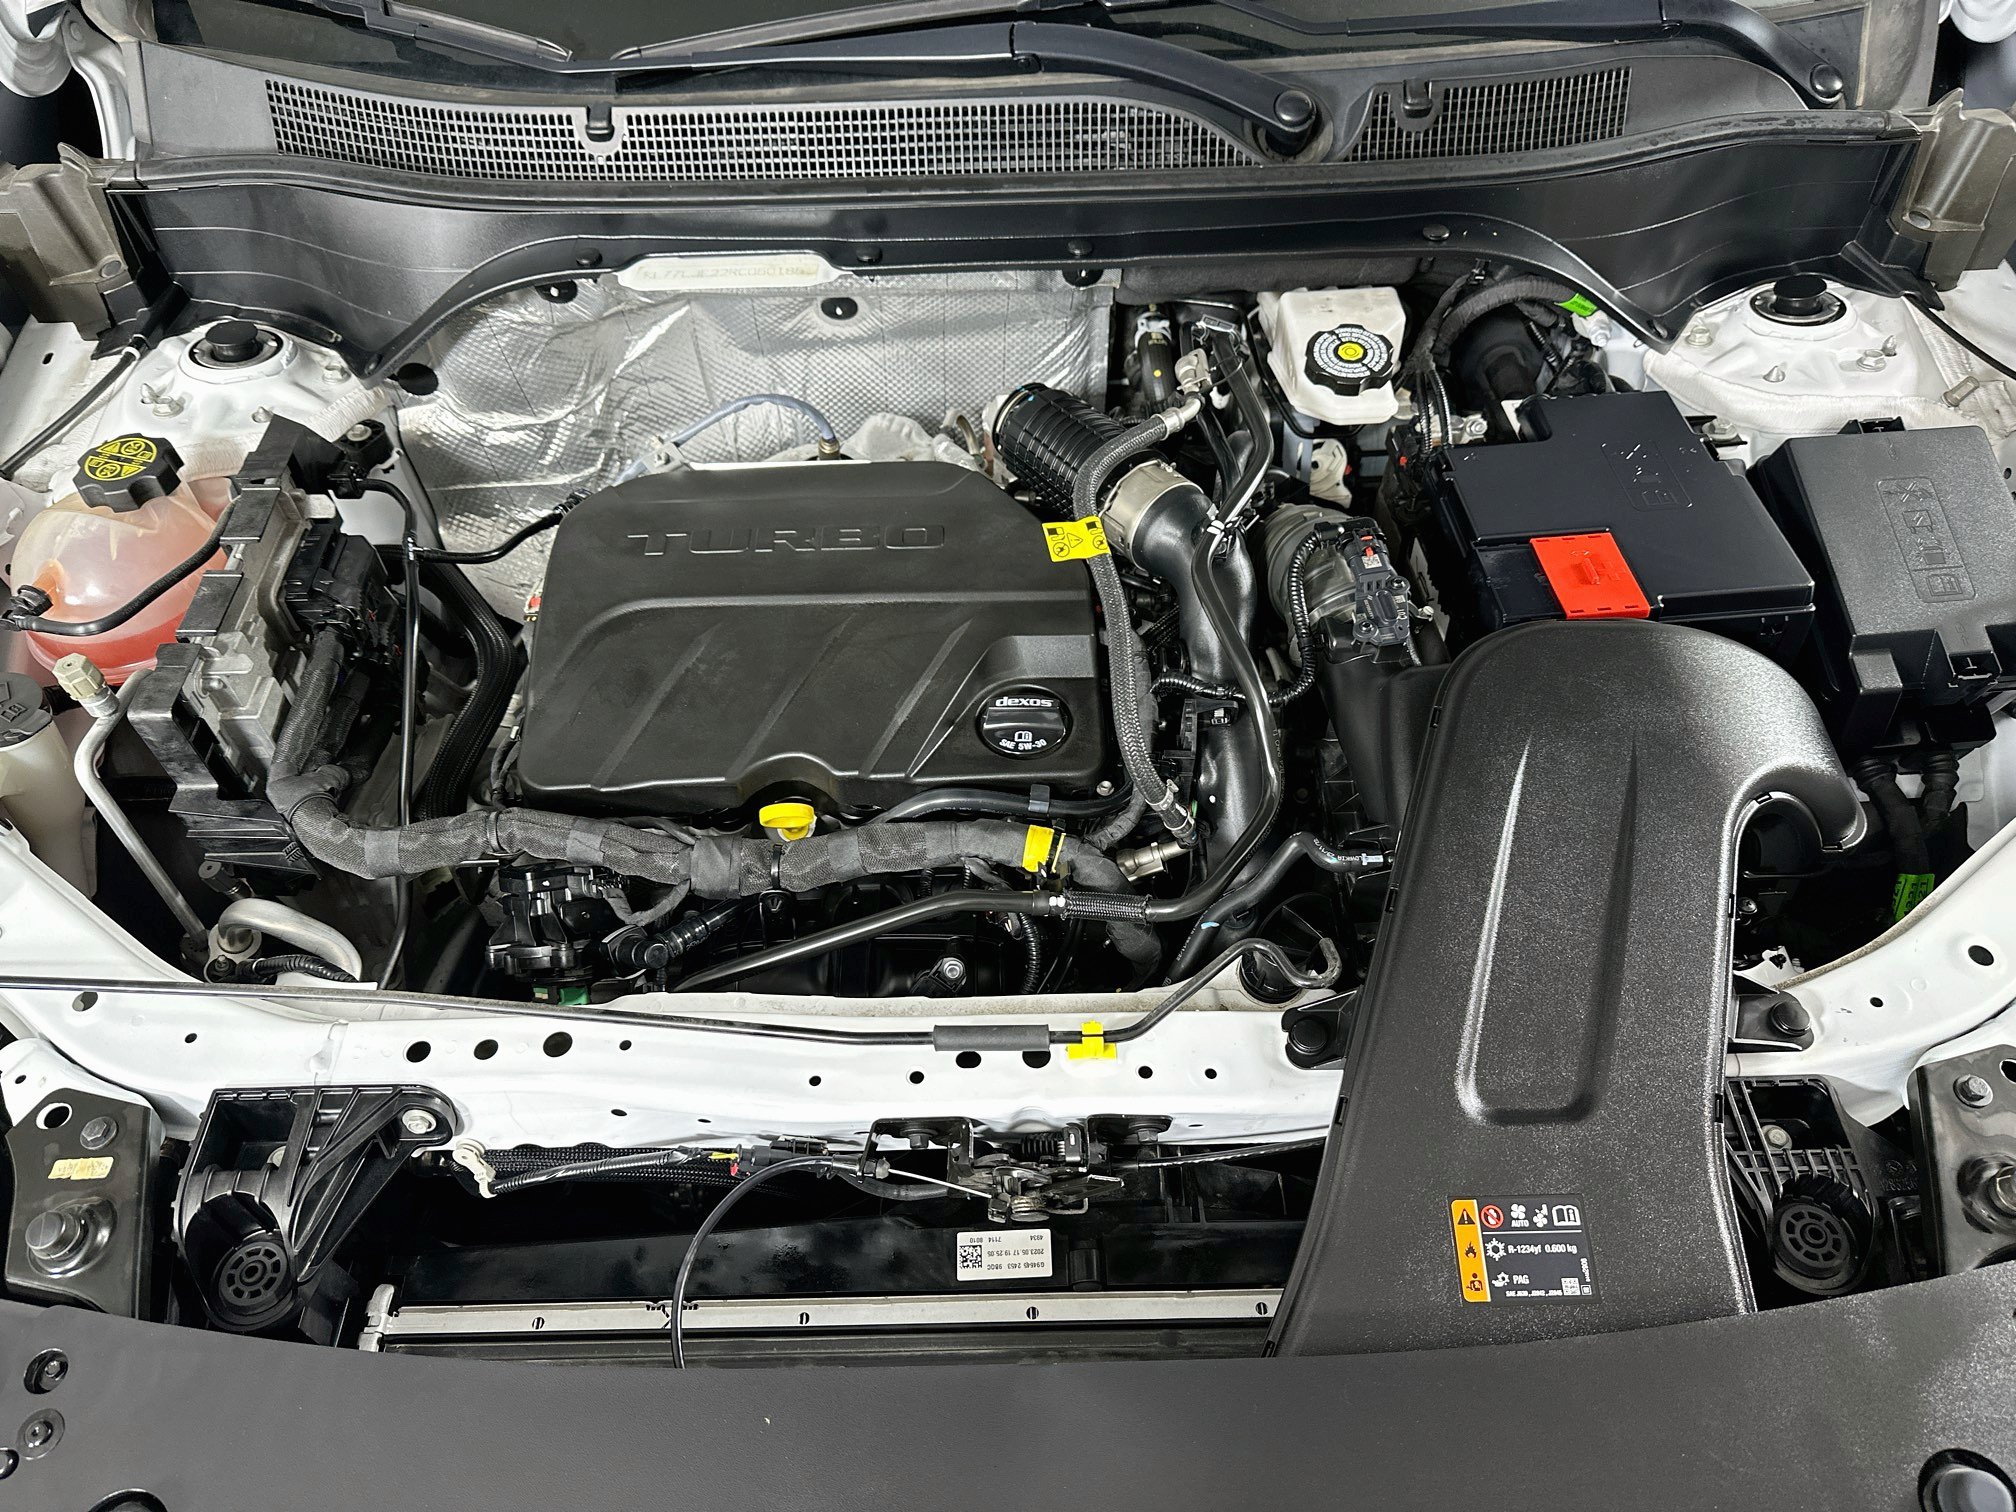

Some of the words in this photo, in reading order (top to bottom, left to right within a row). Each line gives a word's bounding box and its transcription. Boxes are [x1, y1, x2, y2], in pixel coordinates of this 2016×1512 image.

[627, 524, 945, 556] TURBO
[995, 696, 1054, 707] dexos
[999, 738, 1016, 750] SAE
[1018, 738, 1047, 751] 5W-30
[1511, 1219, 1530, 1228] AUTO
[1507, 1244, 1542, 1255] R-1234yf
[1544, 1244, 1566, 1253] 0.600
[1567, 1244, 1578, 1254] kg
[1512, 1274, 1530, 1285] PAG
